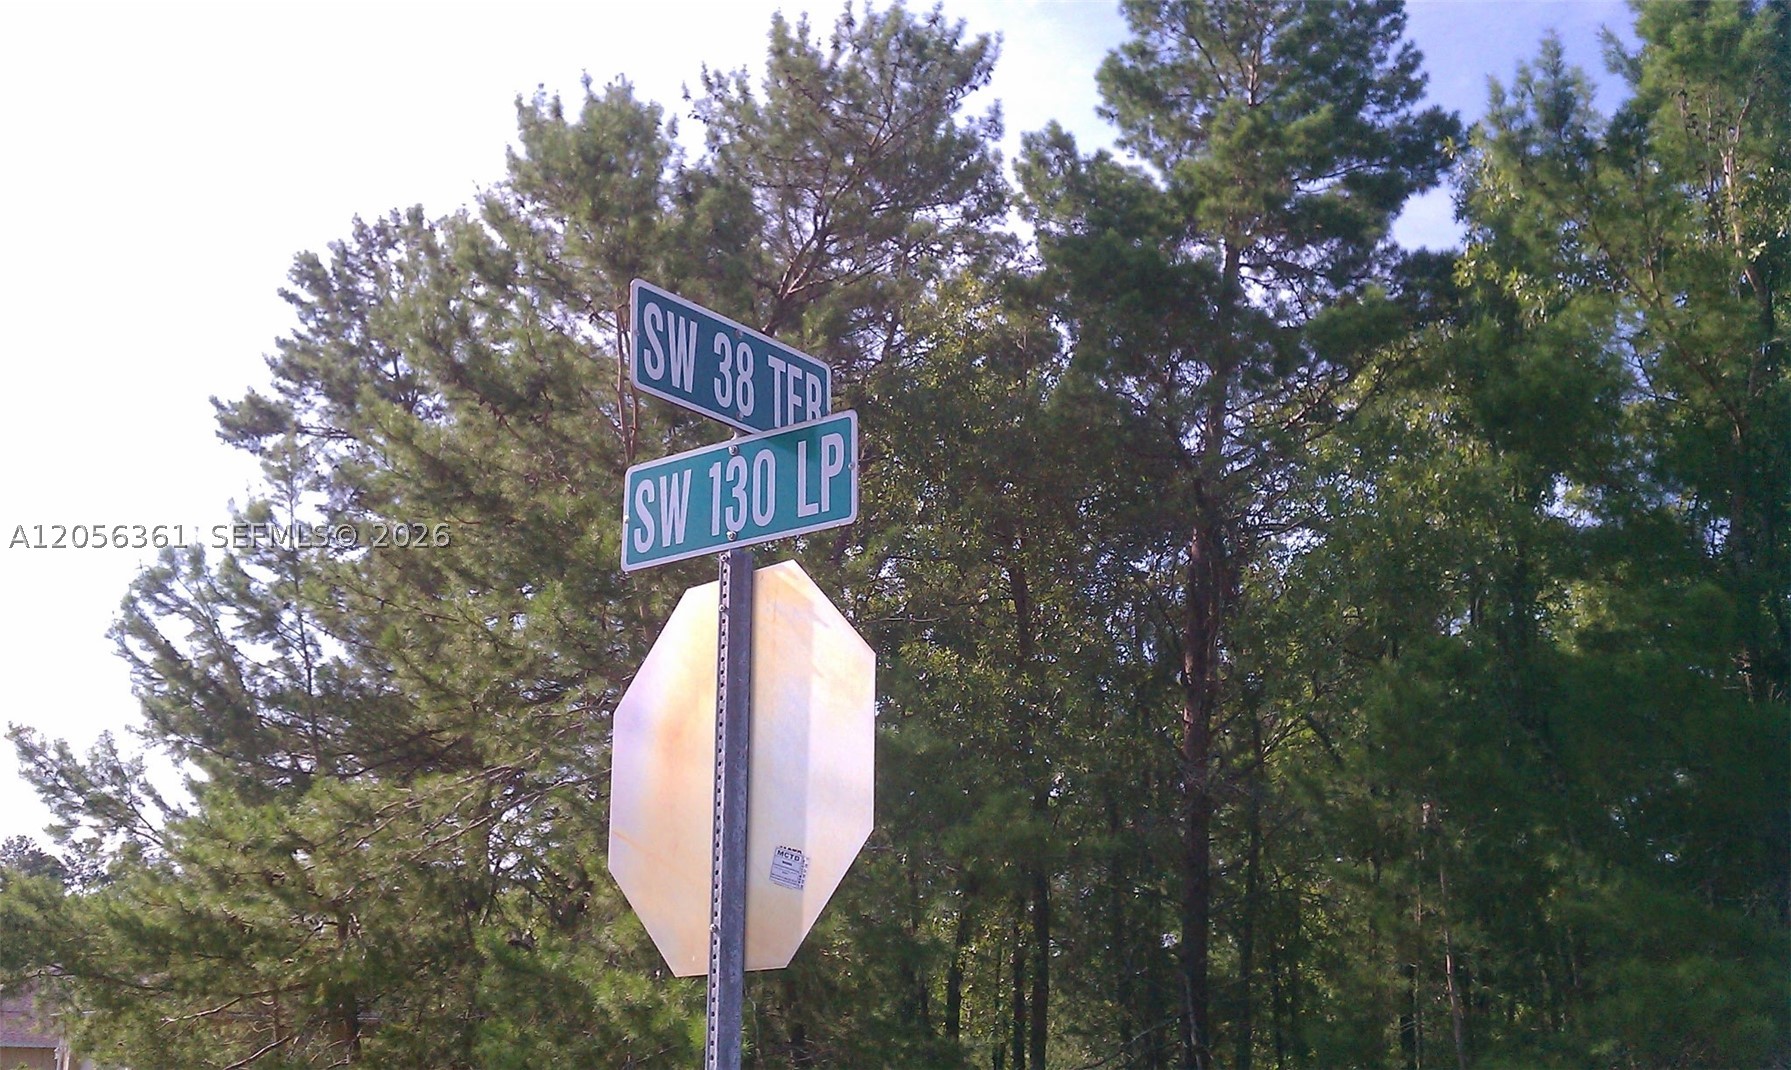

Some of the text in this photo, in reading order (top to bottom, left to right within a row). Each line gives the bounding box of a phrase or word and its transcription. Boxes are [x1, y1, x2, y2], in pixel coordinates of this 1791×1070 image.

[643, 301, 698, 393] SW
[713, 331, 755, 417] 38
[633, 432, 845, 554] SW 130 LP
